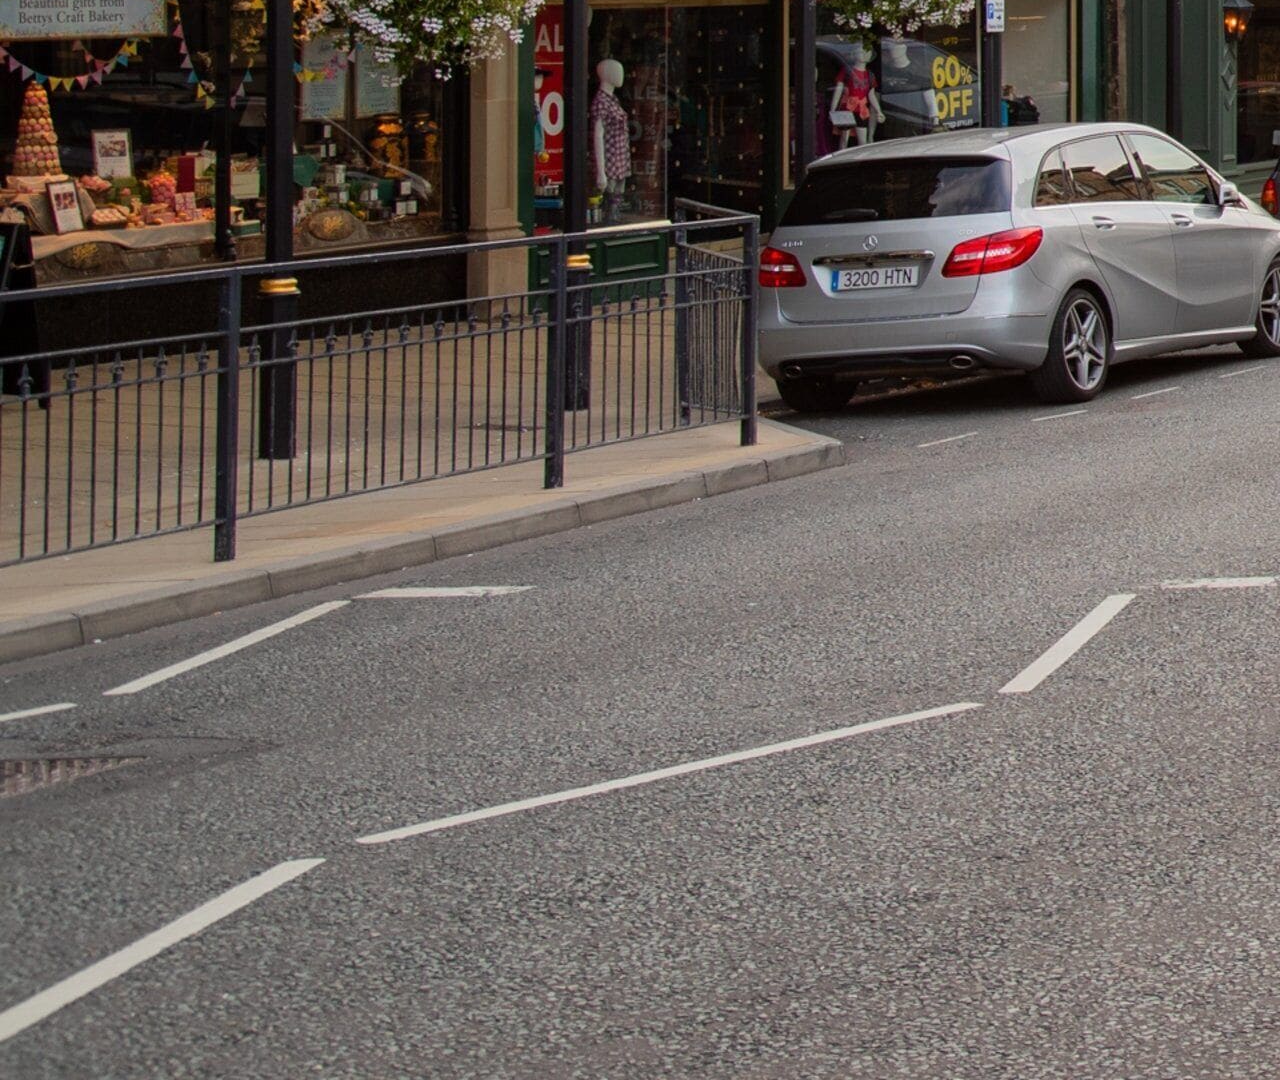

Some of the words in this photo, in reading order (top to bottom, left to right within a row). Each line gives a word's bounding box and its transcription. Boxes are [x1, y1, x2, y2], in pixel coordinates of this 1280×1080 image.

[18, 10, 52, 28] Bettys
[56, 10, 85, 24] Craft
[88, 9, 126, 25] Bakery
[931, 54, 974, 89] 60%
[934, 88, 974, 120] OFF
[843, 269, 880, 289] 3200
[883, 266, 914, 286] HTN
